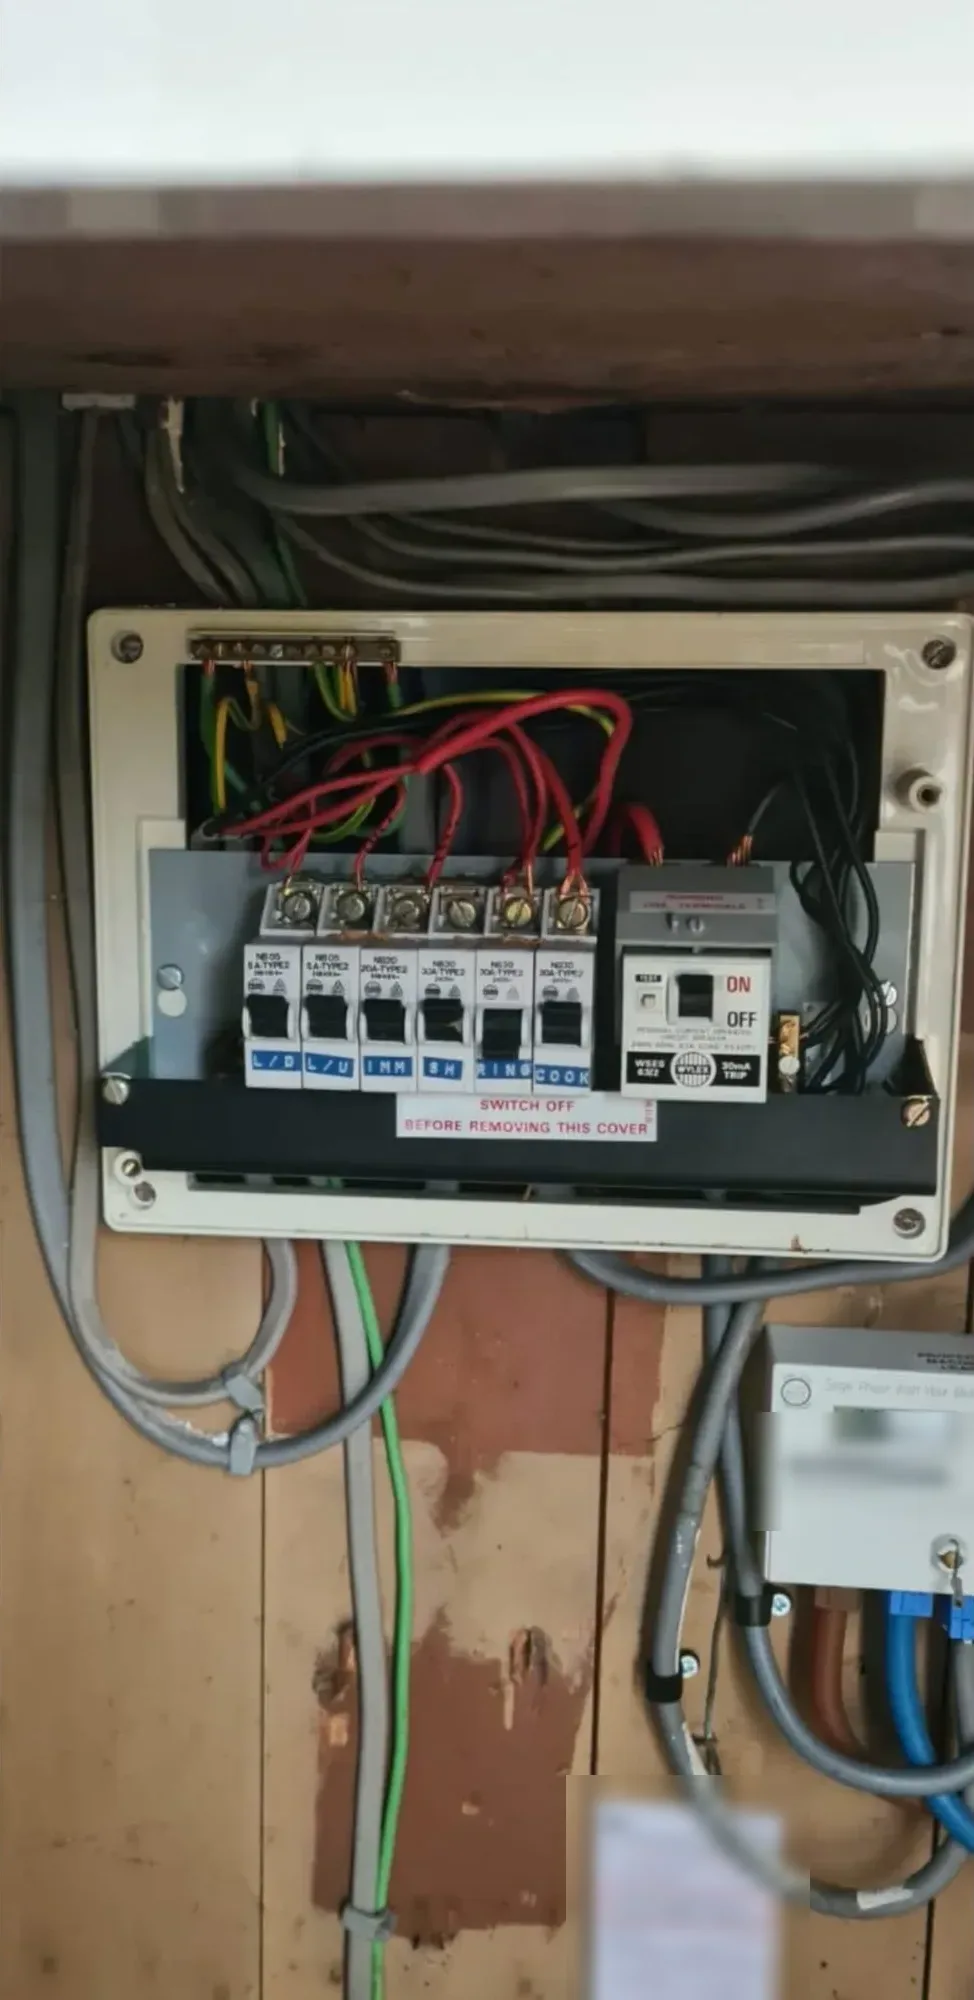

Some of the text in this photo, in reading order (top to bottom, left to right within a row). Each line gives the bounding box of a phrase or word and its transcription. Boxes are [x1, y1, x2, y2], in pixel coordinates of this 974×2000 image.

[726, 976, 751, 992] ON
[727, 1011, 757, 1028] OFF
[367, 1061, 406, 1074] IMM
[477, 1062, 531, 1077] RING
[724, 1071, 748, 1079] TRIP
[536, 1068, 590, 1084] COOK
[480, 1099, 575, 1112] SWITCH OFF
[404, 1119, 648, 1134] BEFORE REMOVING THIS COVER
